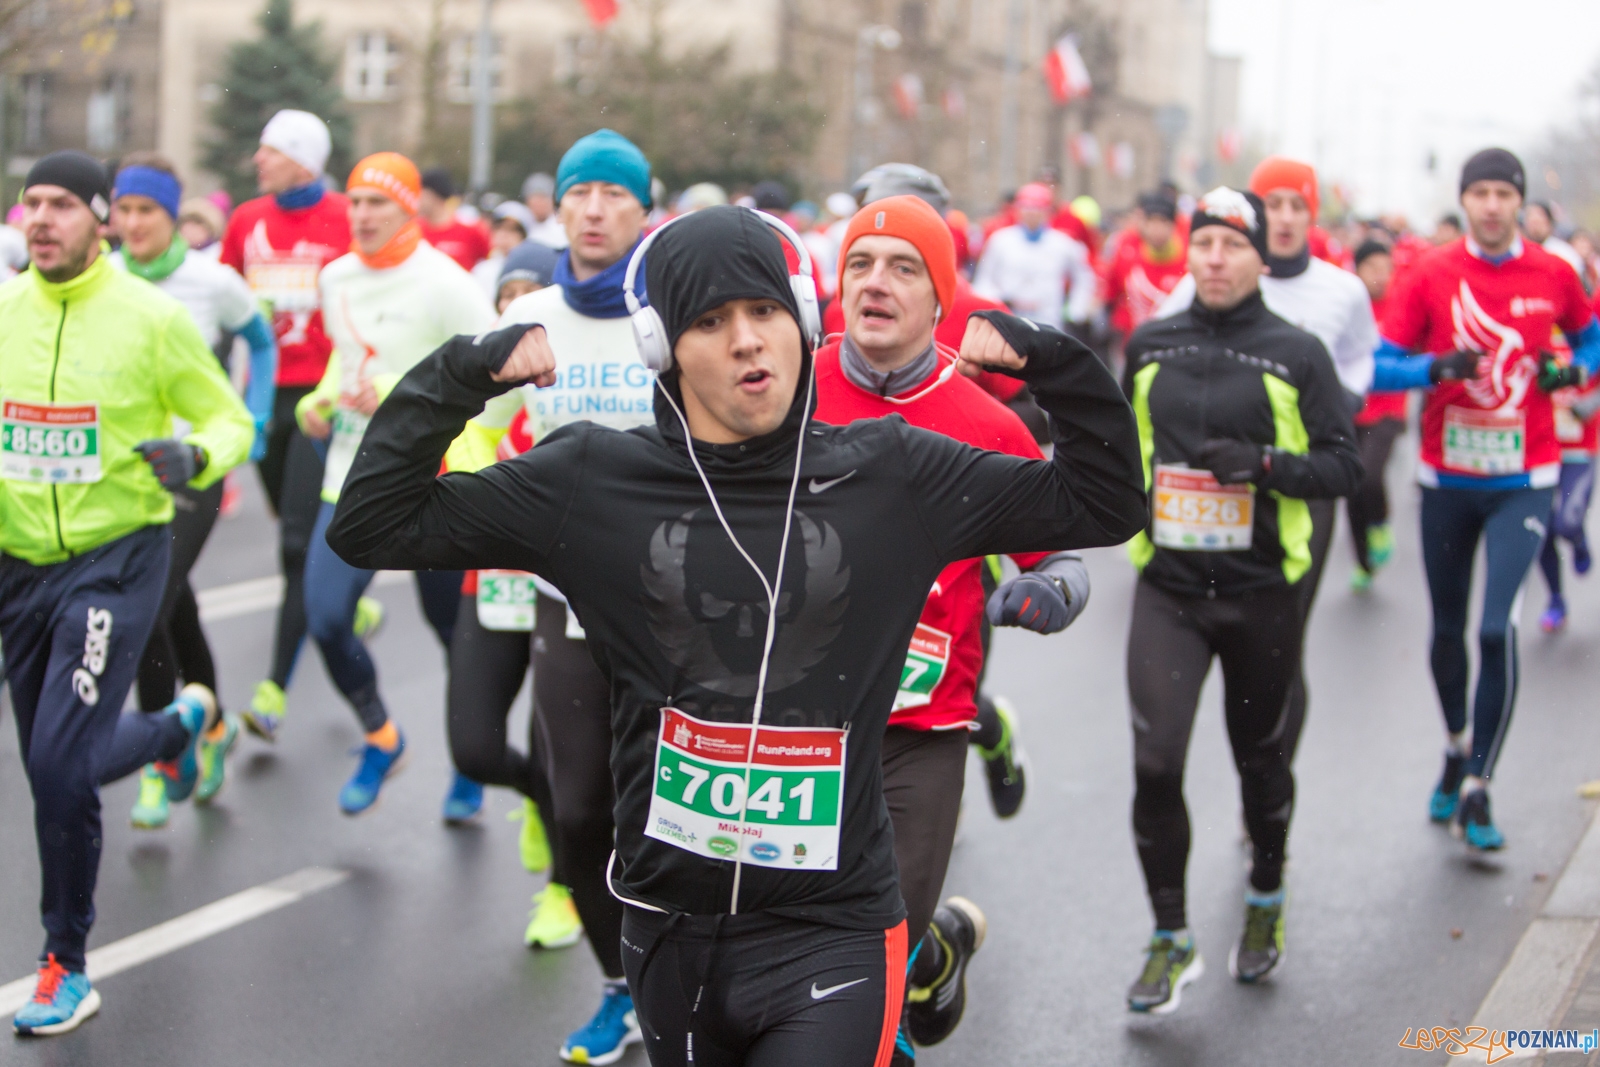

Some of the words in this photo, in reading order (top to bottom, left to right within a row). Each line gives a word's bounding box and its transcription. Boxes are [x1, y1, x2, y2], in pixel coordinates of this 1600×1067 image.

[553, 393, 654, 414] FUNdus
[11, 426, 87, 457] 8560
[1164, 496, 1240, 525] 4526
[756, 743, 832, 758] RunPoland.org
[678, 761, 815, 821] 7041
[656, 825, 687, 843] LUXMED
[658, 817, 683, 833] GRUPA
